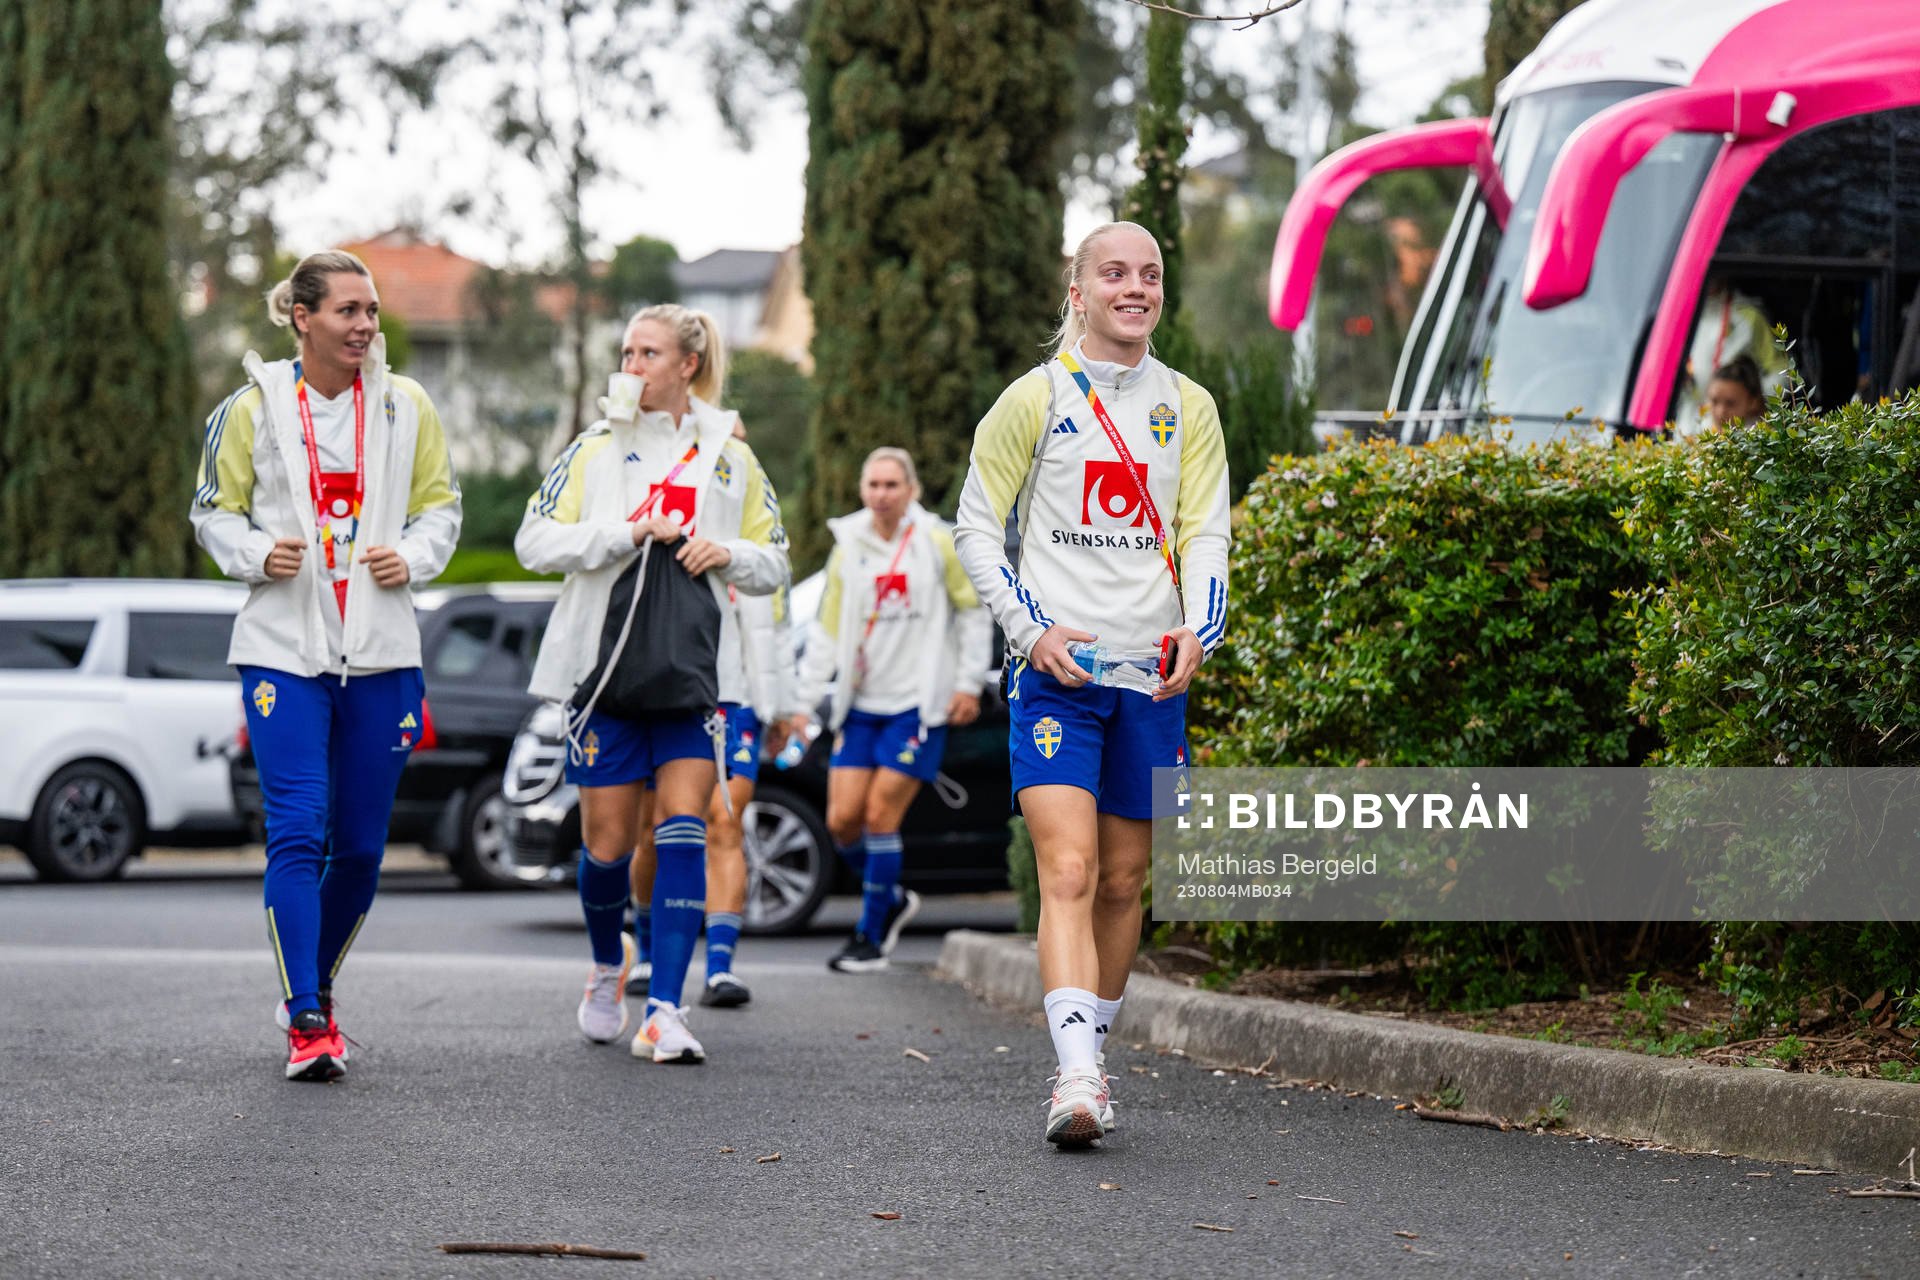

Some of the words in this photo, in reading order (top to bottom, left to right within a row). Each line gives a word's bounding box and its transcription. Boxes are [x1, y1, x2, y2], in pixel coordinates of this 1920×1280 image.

[1126, 460, 1139, 481] WORLD
[1052, 530, 1129, 548] SVENSKA
[1135, 536, 1161, 550] SPE
